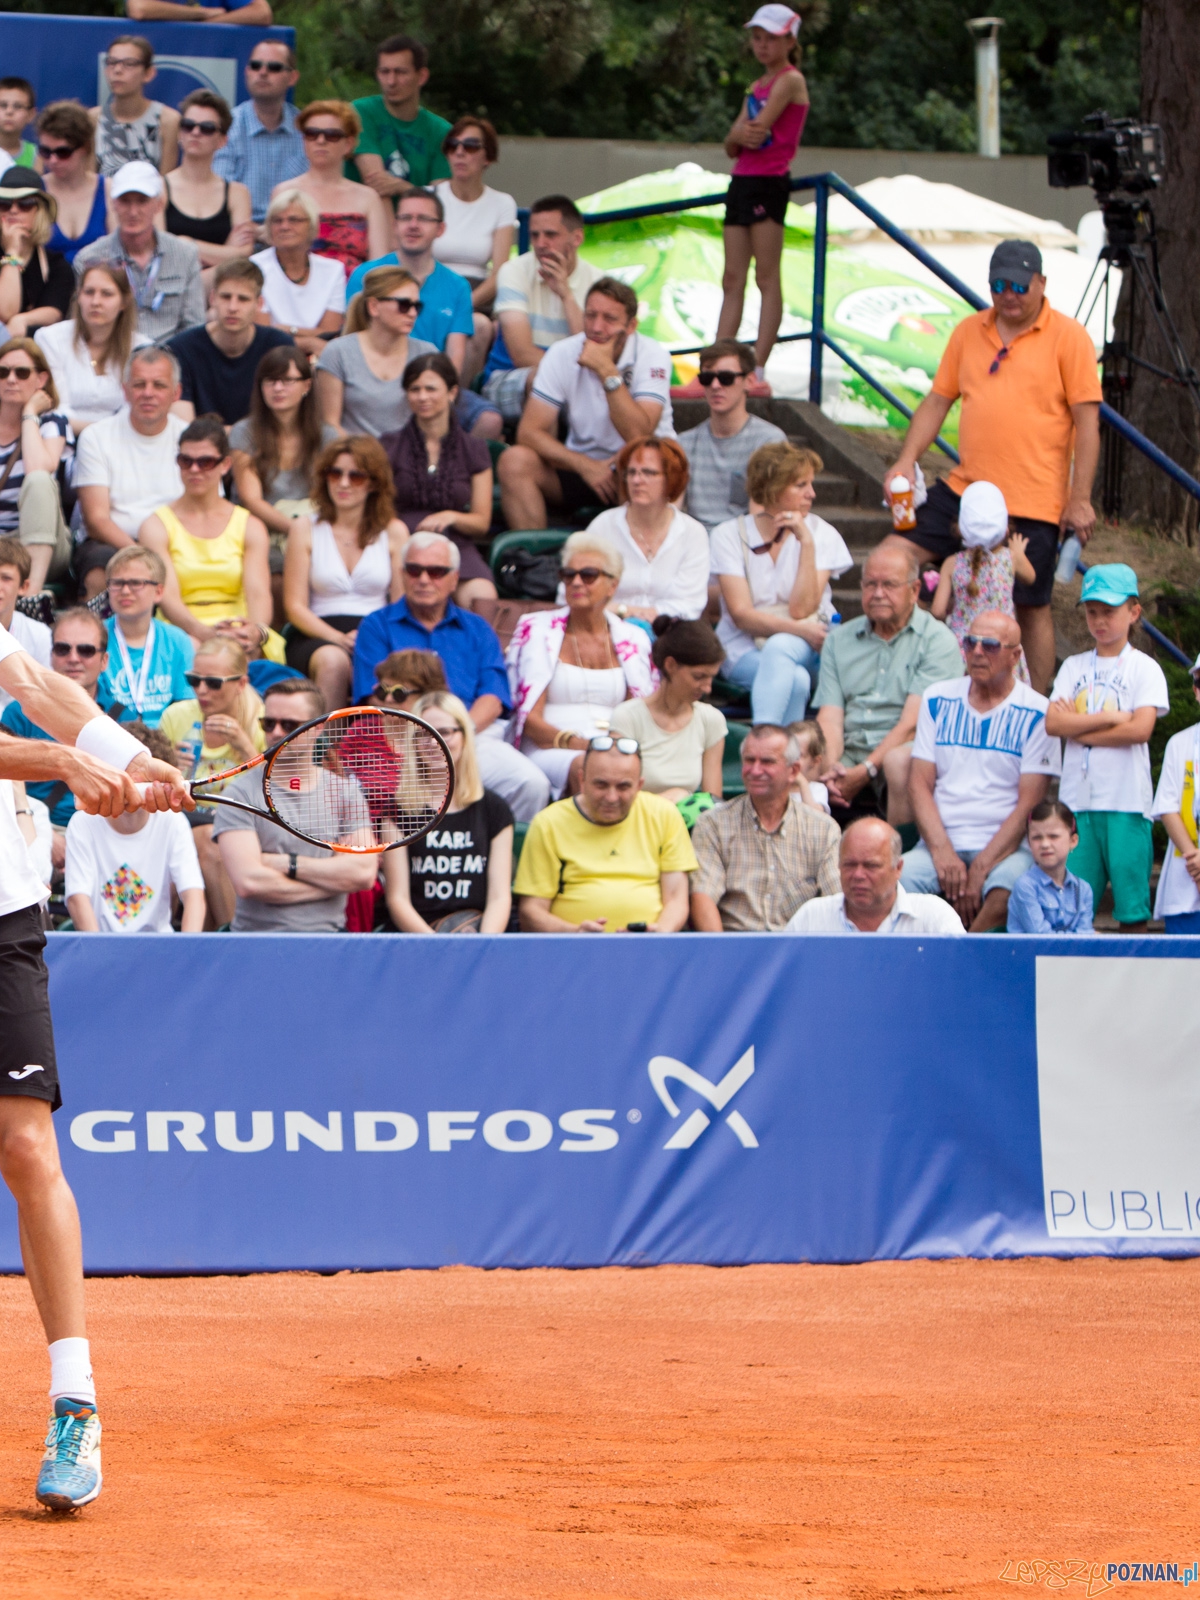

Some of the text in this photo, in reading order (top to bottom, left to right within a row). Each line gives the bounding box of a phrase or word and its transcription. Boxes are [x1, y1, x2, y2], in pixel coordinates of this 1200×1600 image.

[426, 830, 474, 849] KARL
[424, 879, 472, 900] DO IT
[1051, 1190, 1200, 1231] PUBLI
